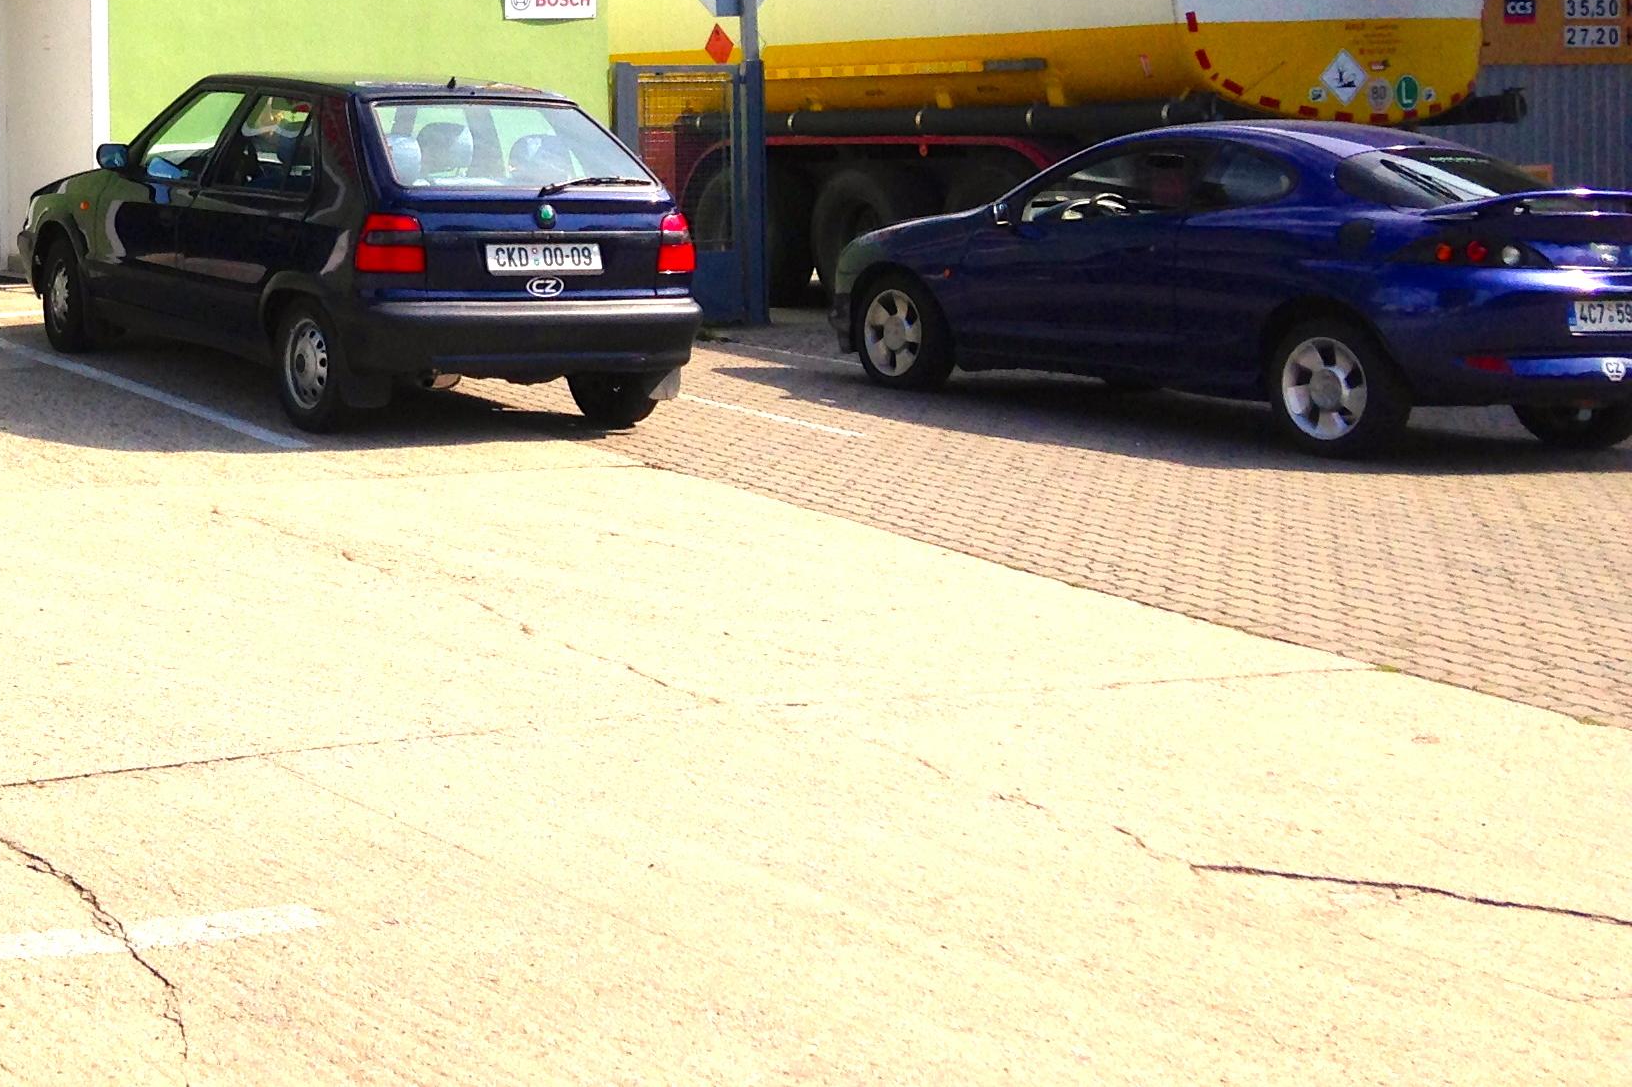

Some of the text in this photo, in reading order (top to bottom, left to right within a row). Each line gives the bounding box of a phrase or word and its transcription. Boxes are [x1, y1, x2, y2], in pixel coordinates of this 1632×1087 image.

[1506, 1, 1534, 15] CCS
[1401, 80, 1413, 104] L
[495, 245, 593, 268] CKD 00-09
[531, 280, 557, 293] CZ
[1579, 303, 1605, 323] 4C7
[1605, 361, 1622, 374] CZ
